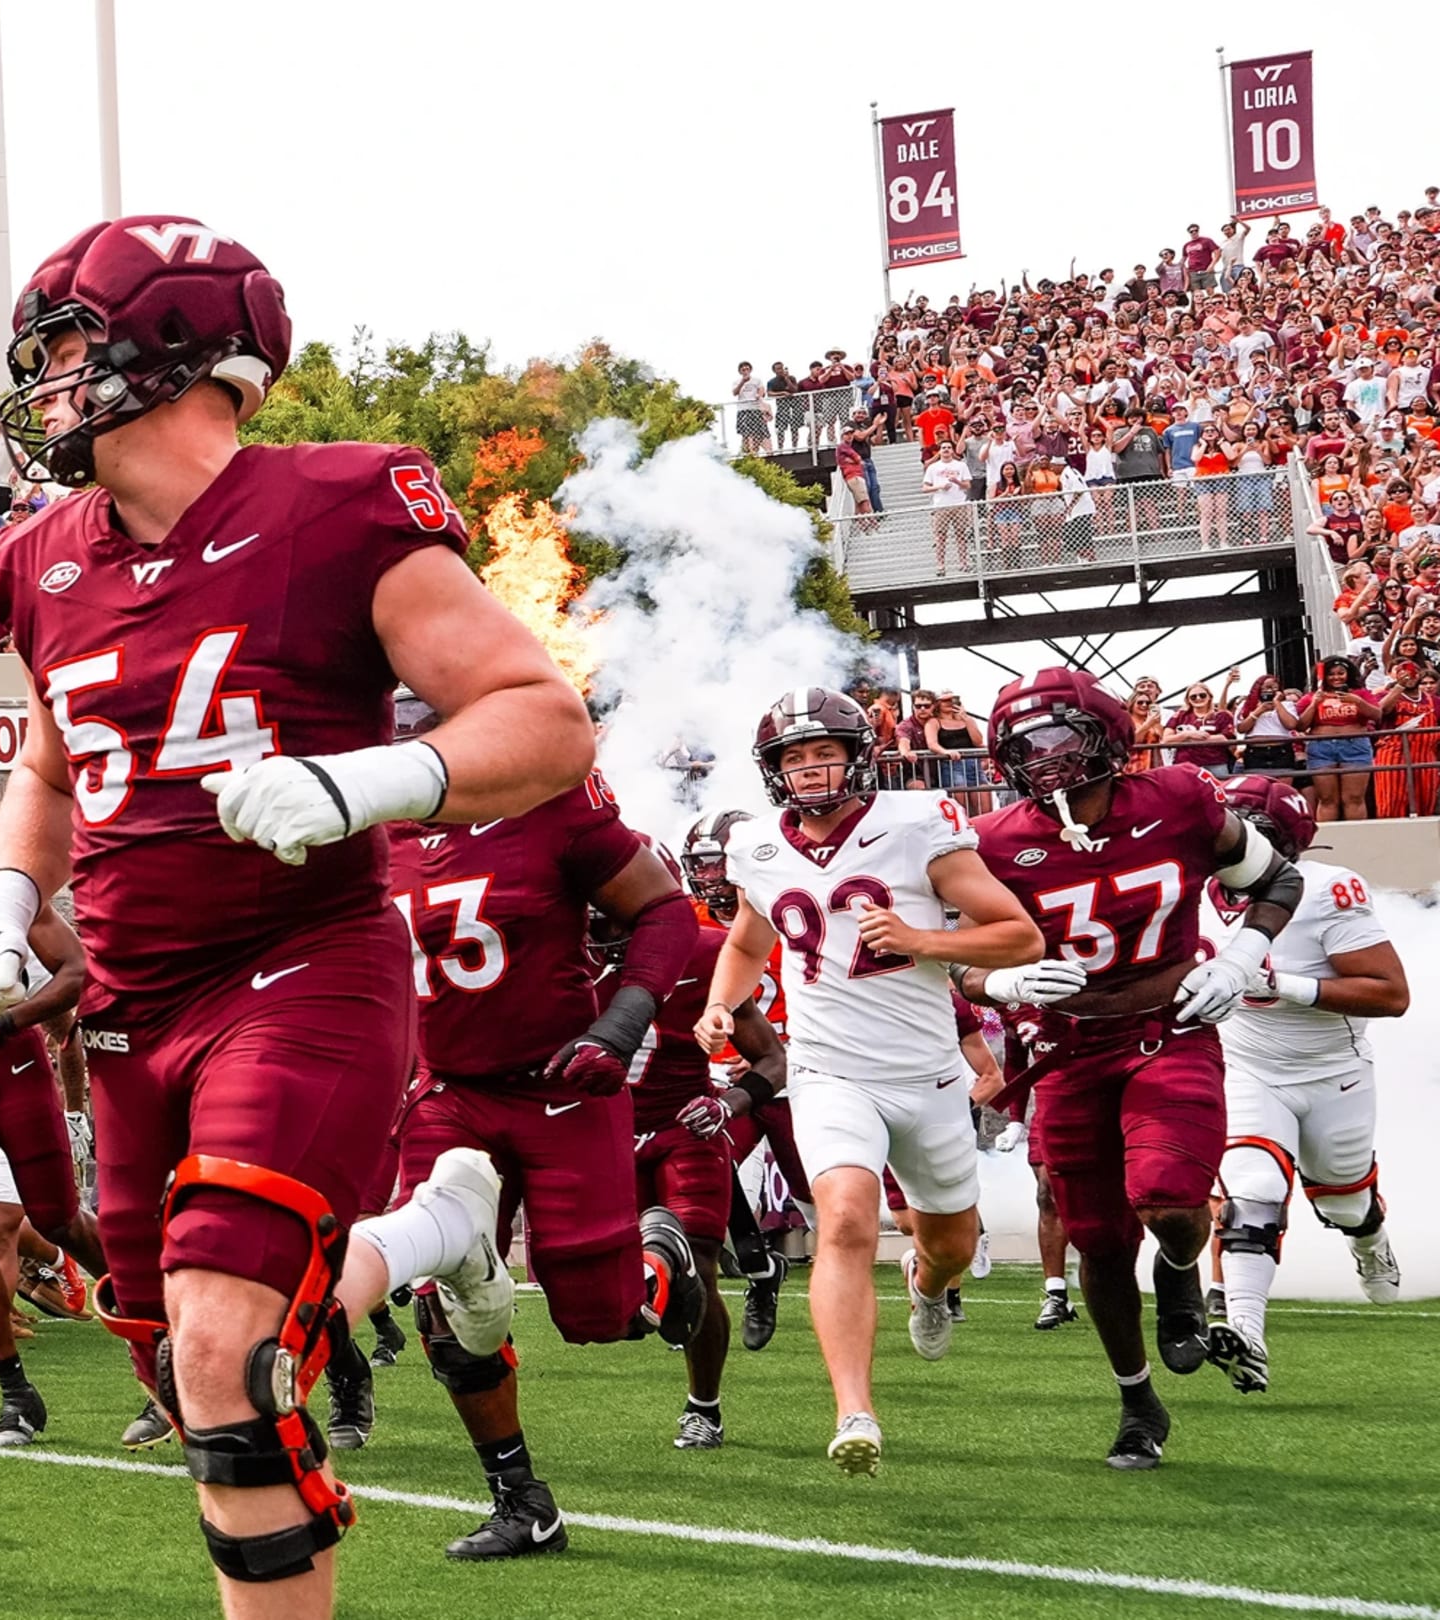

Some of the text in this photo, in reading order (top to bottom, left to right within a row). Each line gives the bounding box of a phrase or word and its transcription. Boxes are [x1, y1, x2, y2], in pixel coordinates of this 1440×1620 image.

[1253, 63, 1293, 82] VT
[1243, 84, 1298, 110] LORIA
[902, 119, 937, 137] VT
[896, 139, 940, 163] DALE
[1246, 118, 1302, 173] 10
[888, 169, 956, 223] 84
[1241, 191, 1315, 212] HOKIES
[125, 223, 234, 264] VT
[893, 241, 959, 261] HOKIES
[131, 558, 176, 585] VT
[43, 624, 282, 830] 54
[418, 833, 448, 849] VT
[808, 846, 836, 860] VT
[1330, 878, 1368, 912] 88
[1033, 857, 1186, 974] 37
[391, 872, 509, 1001] 13
[769, 874, 917, 985] 92
[83, 1030, 130, 1053] OKIES
